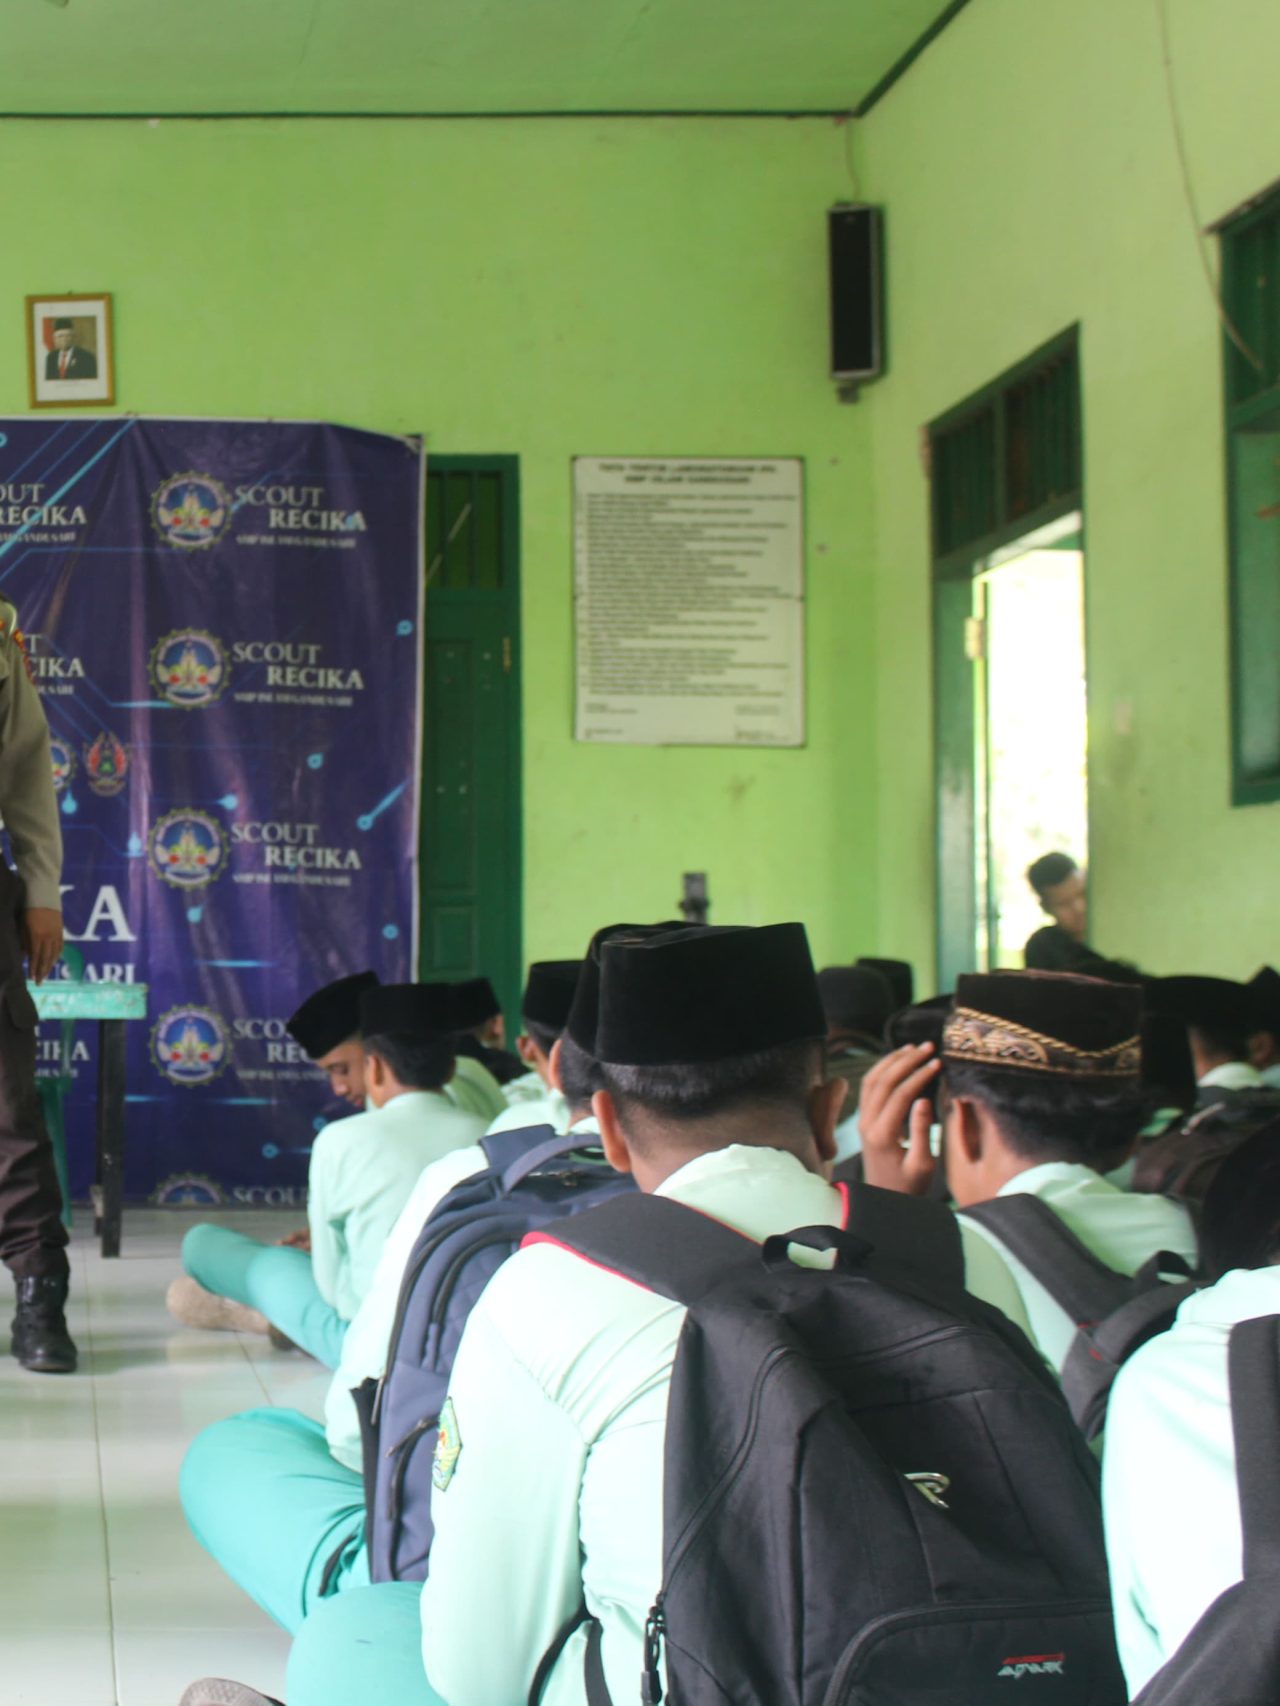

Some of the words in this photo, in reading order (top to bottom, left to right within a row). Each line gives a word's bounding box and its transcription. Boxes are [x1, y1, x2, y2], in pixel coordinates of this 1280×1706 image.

[235, 485, 324, 507] SCOUT
[269, 508, 367, 531] RECIKA
[232, 642, 322, 665] SCOUT
[267, 665, 365, 690] RECIKA
[231, 822, 320, 845] SCOUT
[265, 845, 362, 870] RECIKA
[233, 1019, 294, 1040] SCO
